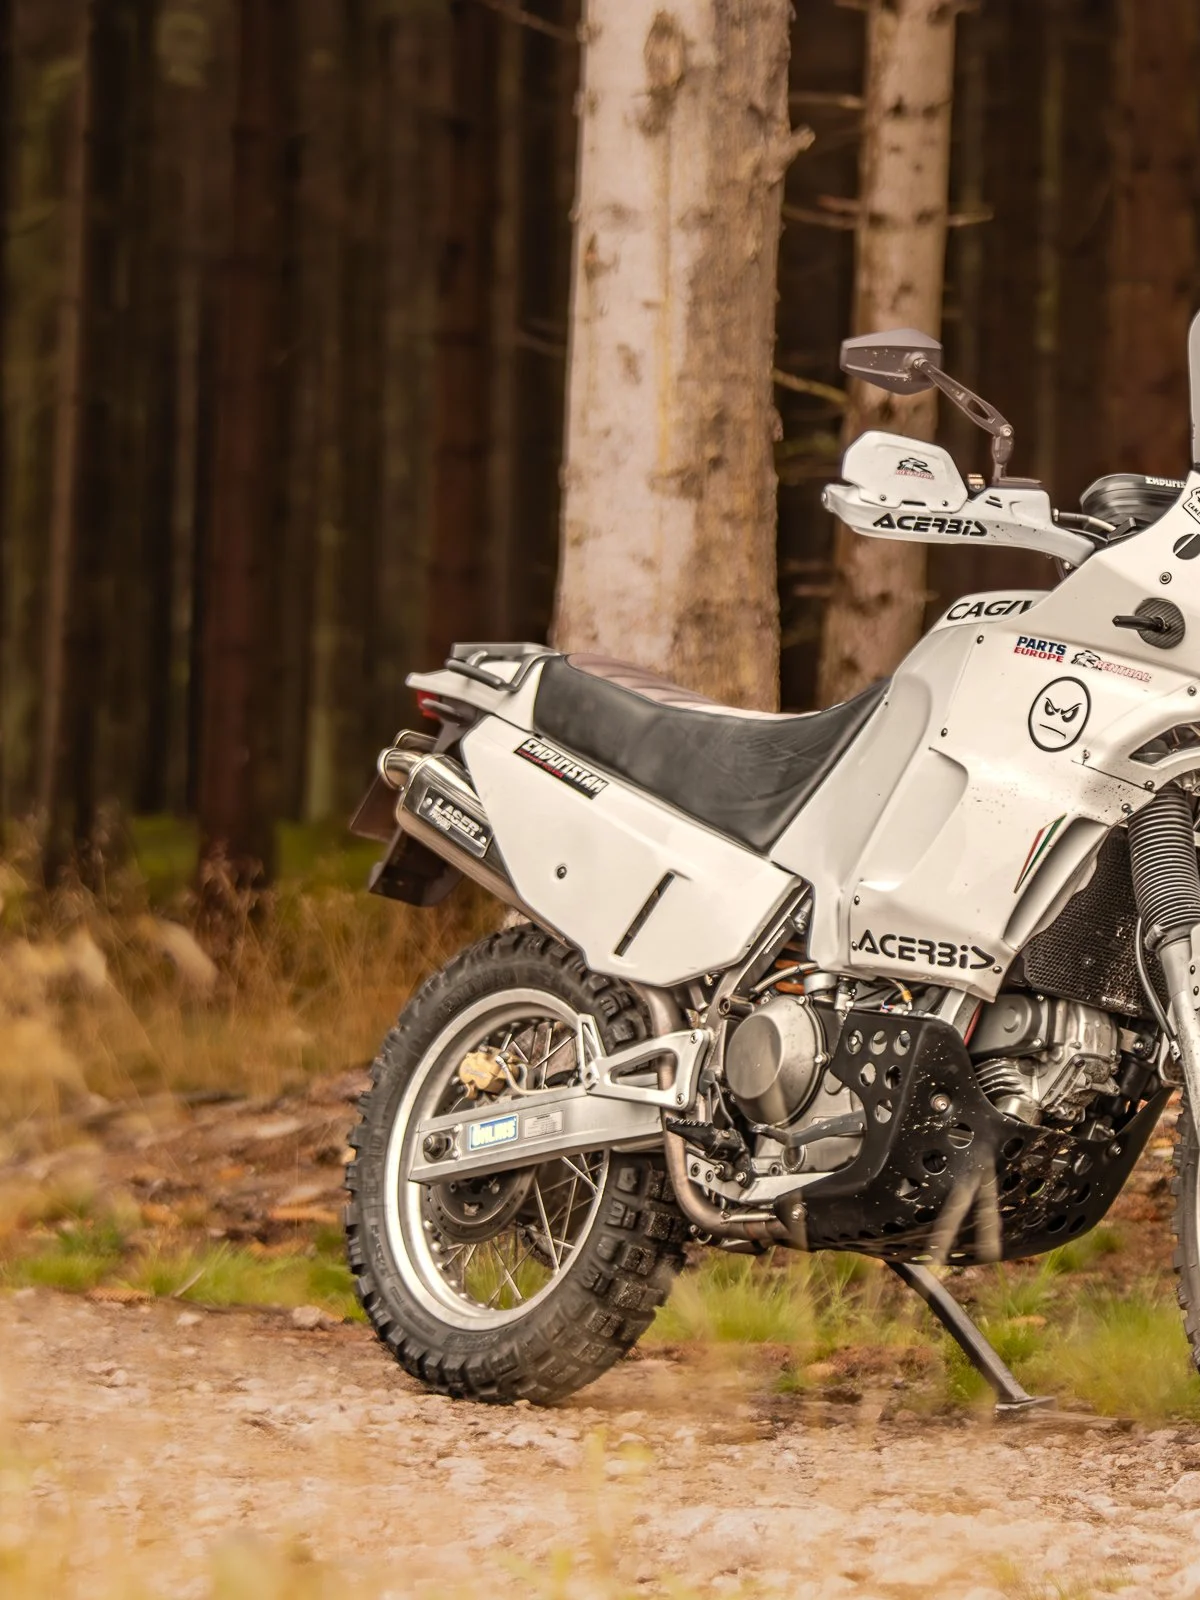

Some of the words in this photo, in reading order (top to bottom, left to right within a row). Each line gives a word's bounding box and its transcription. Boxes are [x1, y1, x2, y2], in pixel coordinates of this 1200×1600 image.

[1013, 646, 1065, 664] EUROPE
[1016, 635, 1068, 656] PARTS
[1093, 659, 1151, 683] RENTHAL
[432, 797, 480, 837] LASER
